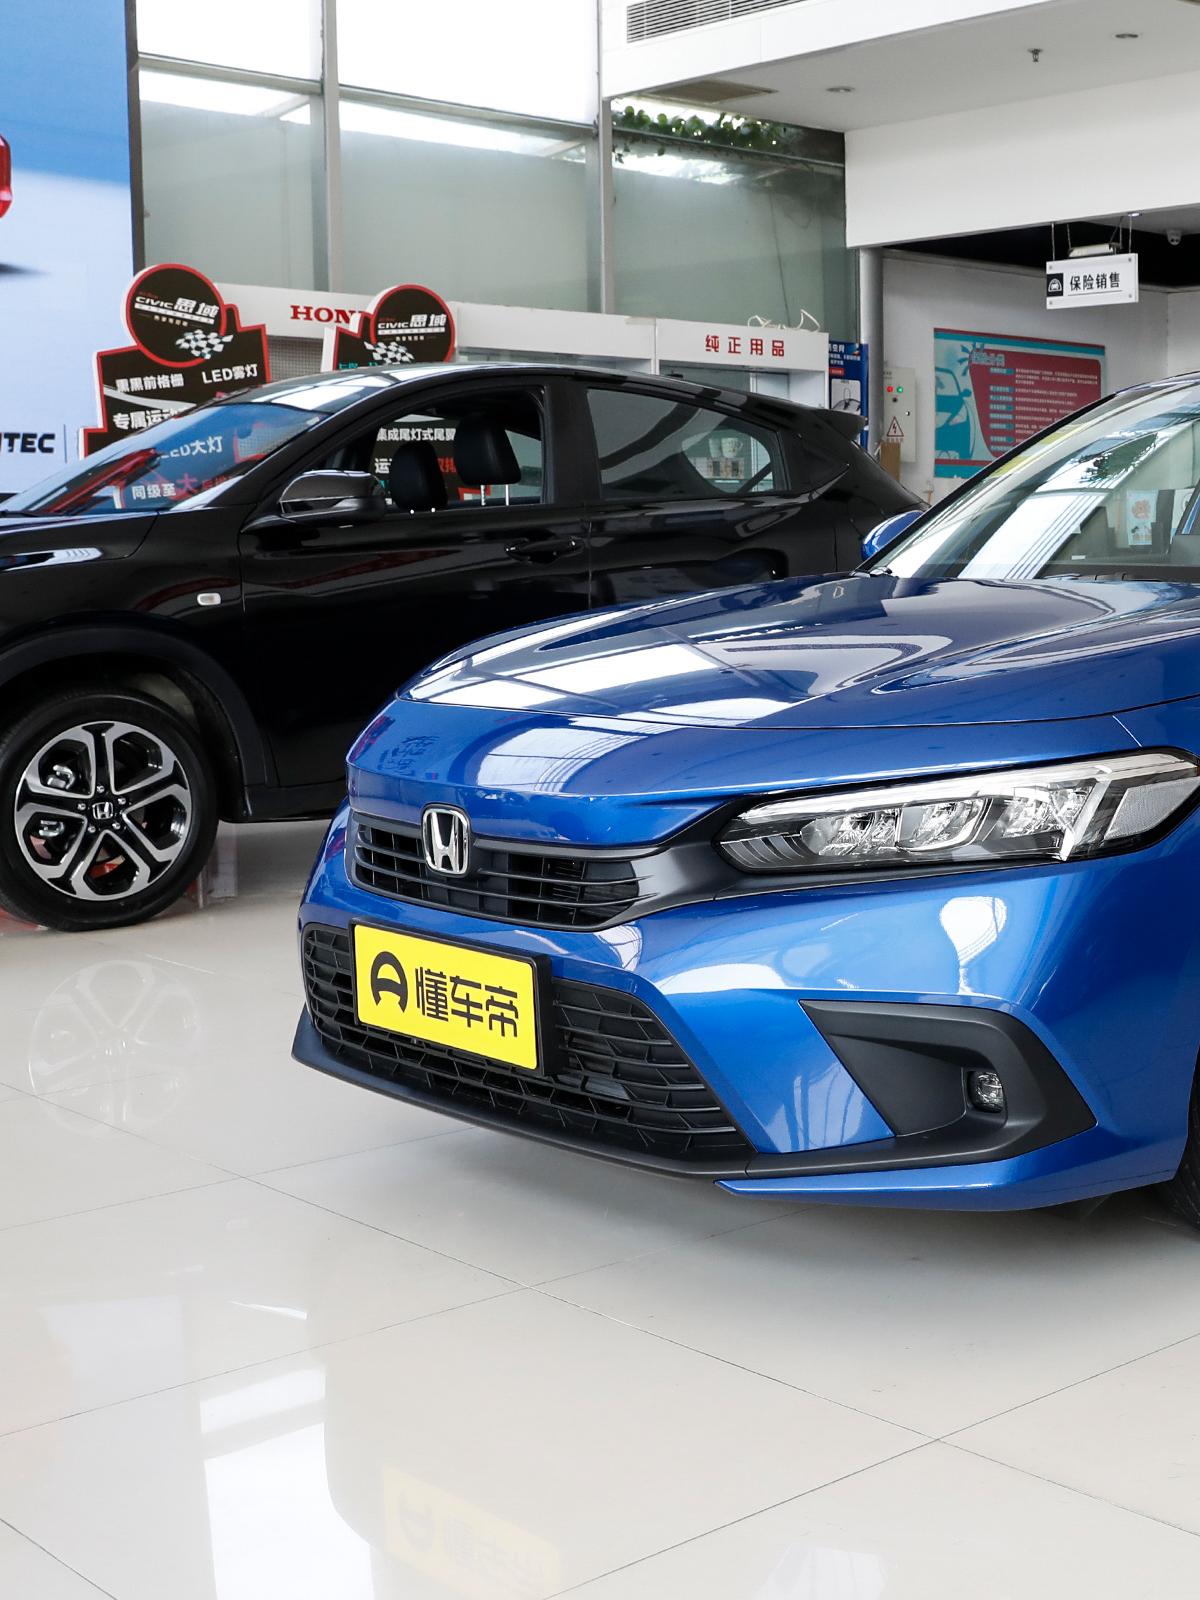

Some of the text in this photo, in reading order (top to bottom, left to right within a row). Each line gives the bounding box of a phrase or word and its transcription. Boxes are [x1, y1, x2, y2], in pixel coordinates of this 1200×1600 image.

[1070, 271, 1121, 292] 保险销售
[135, 296, 175, 310] CIVIC
[174, 297, 220, 318] 思域
[290, 305, 360, 324] HON
[377, 321, 409, 329] CIVIC
[409, 313, 448, 328] 思域
[704, 334, 785, 357] 纯正用品
[201, 364, 259, 385] LED雾灯
[0, 432, 56, 453] TEC
[414, 966, 519, 1038] 懂车帝
